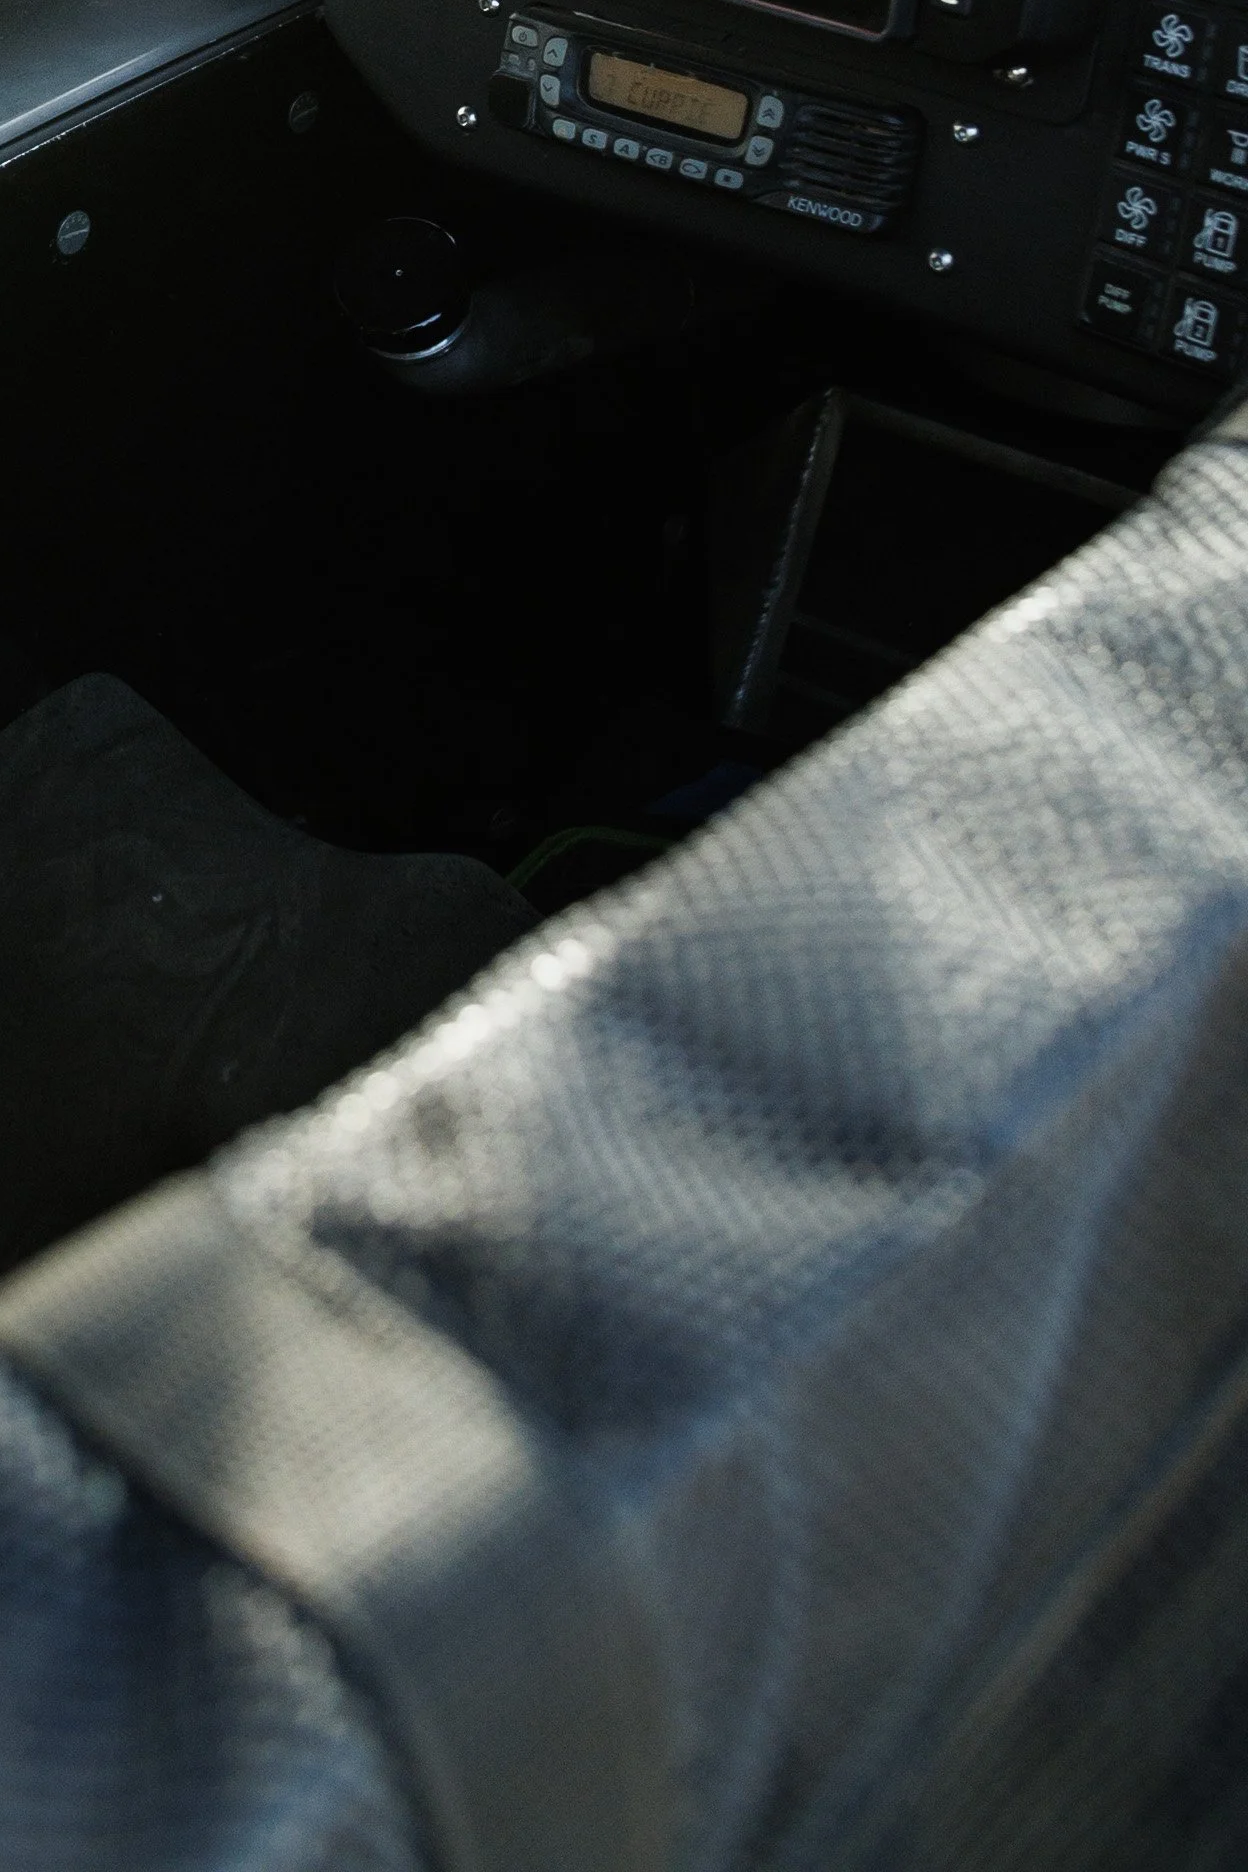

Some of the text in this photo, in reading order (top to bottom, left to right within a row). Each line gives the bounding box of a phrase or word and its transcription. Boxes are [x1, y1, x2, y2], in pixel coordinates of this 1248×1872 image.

[1142, 53, 1192, 79] TRANS
[619, 144, 630, 155] A
[1125, 140, 1172, 166] PWR S
[788, 195, 862, 227] KENWOOD
[1115, 228, 1148, 247] DIFF
[1193, 251, 1238, 274] PUMP
[1174, 339, 1219, 363] PUMP
